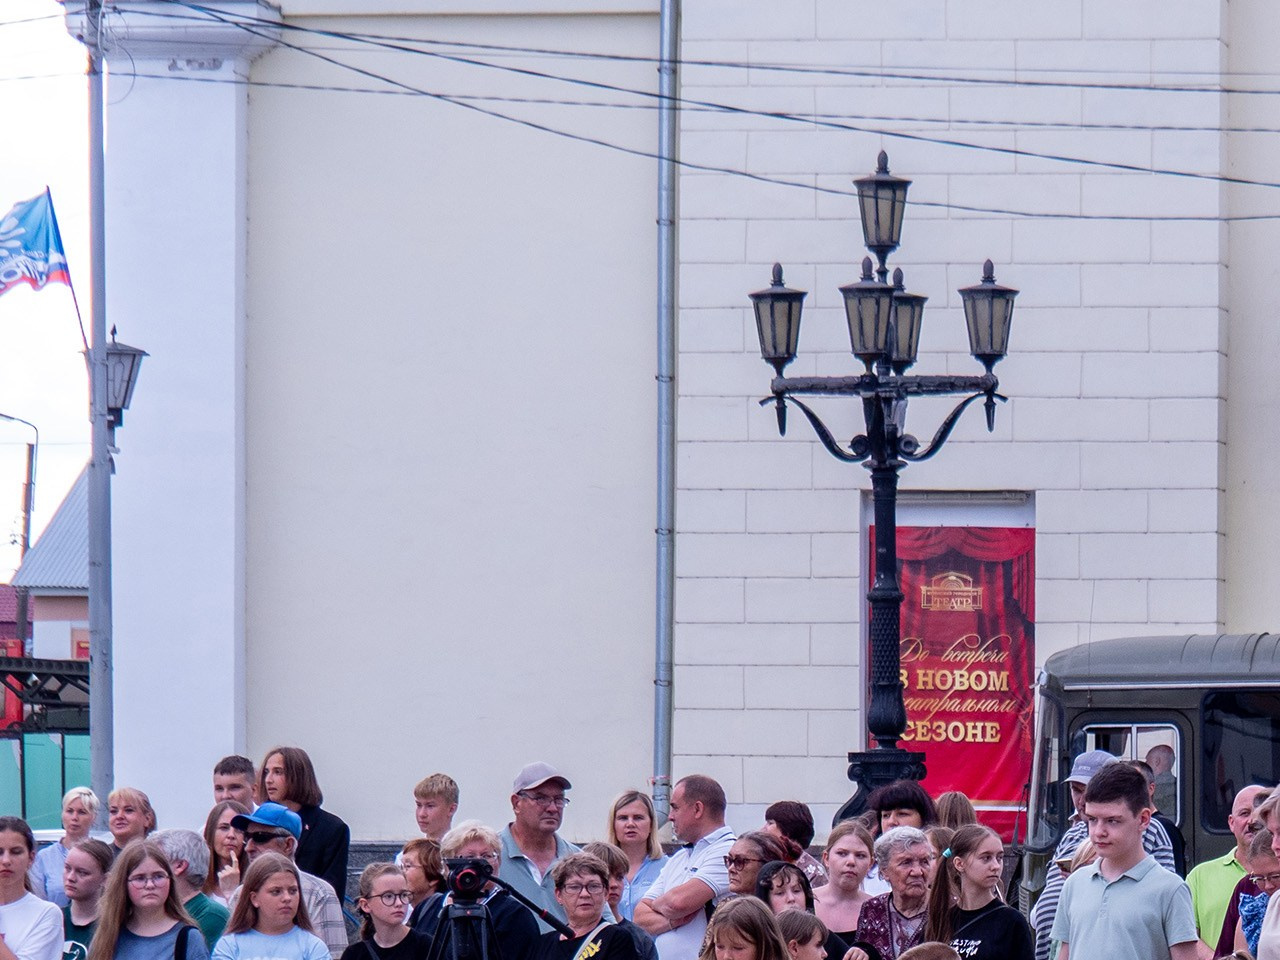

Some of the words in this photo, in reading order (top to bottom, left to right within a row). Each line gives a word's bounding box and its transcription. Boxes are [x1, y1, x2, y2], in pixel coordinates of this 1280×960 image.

[934, 597, 972, 610] ТЕАТР
[916, 669, 1010, 692] НОВОМ
[900, 720, 1001, 743] СЕЗОНЕ
